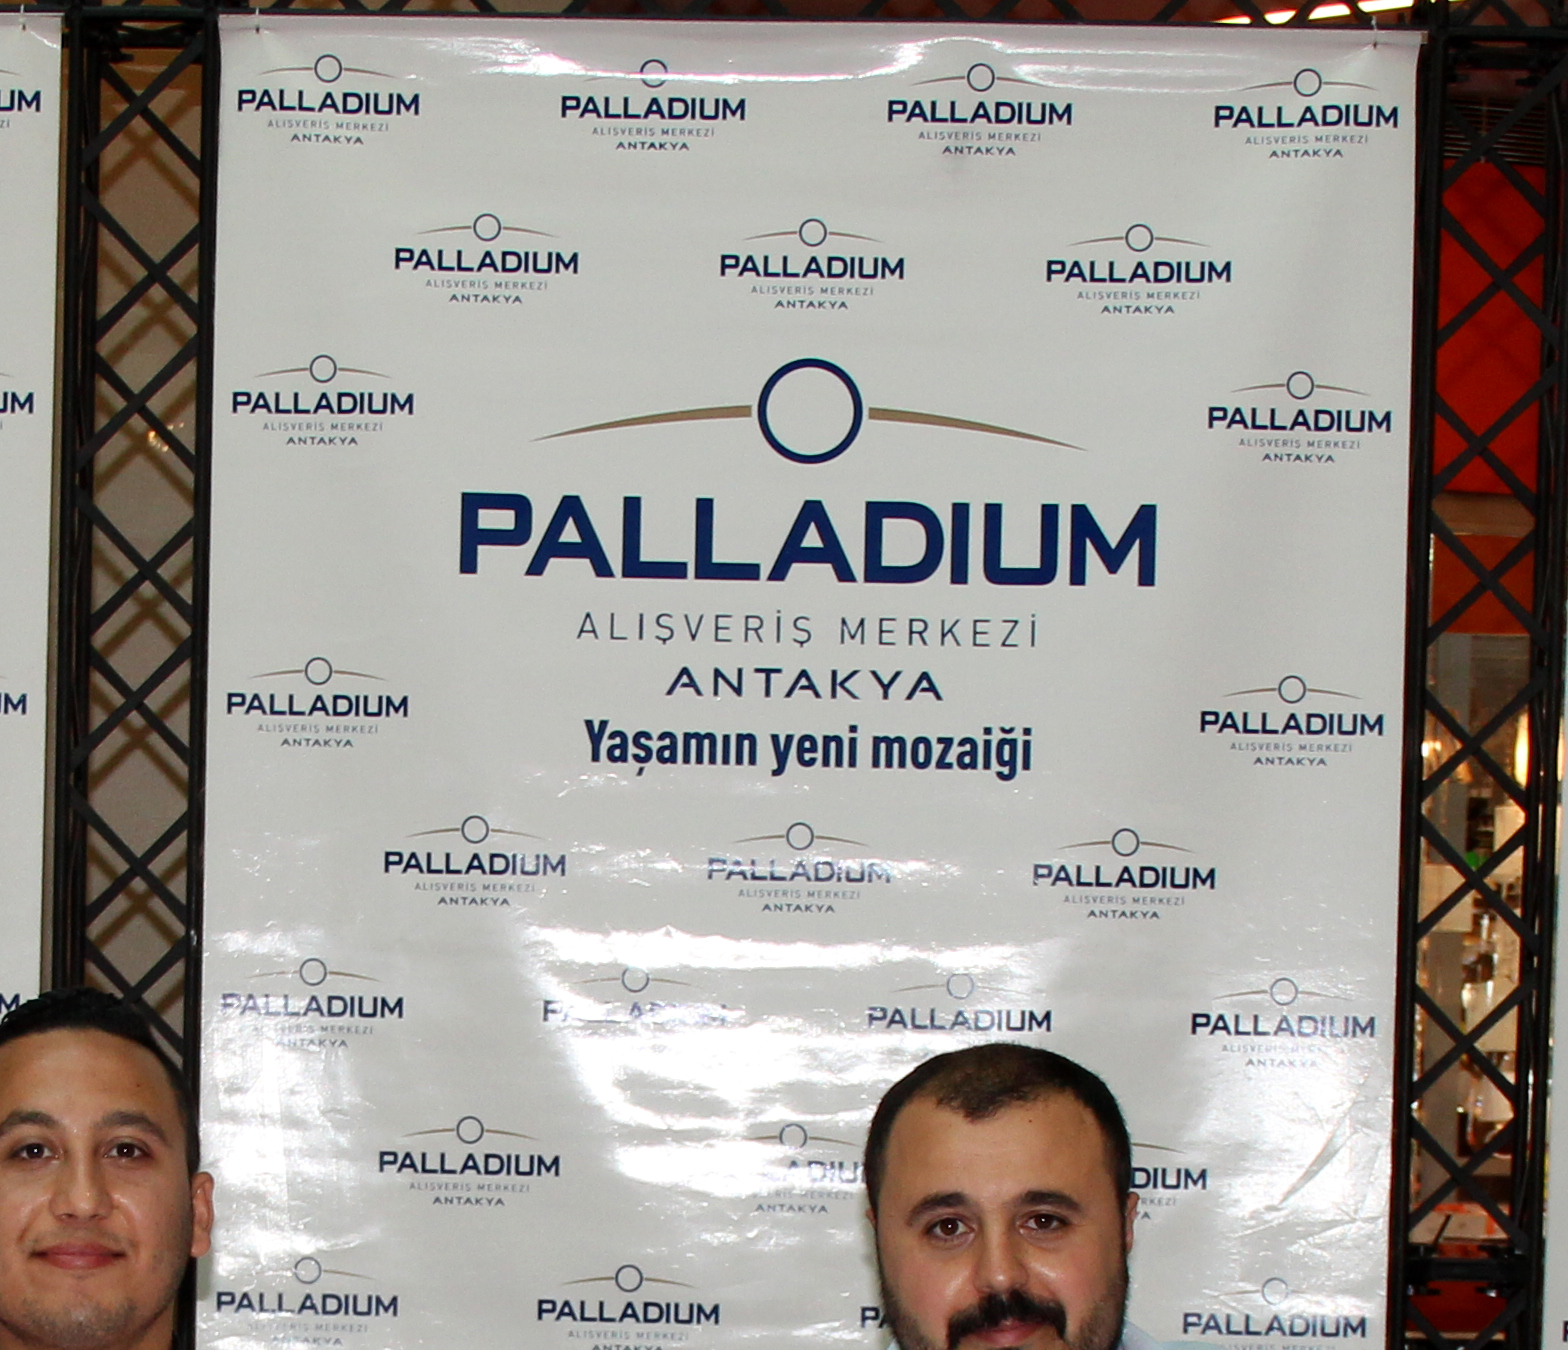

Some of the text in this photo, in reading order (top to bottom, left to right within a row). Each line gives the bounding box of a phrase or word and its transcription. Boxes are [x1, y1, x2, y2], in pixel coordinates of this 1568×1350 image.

[238, 89, 419, 115] PALLADIUM
[562, 96, 745, 120] PALLADIUM
[888, 100, 1072, 125] PALLADIUM
[1215, 104, 1398, 128] PALLADIUM
[616, 142, 689, 150] ANTAKYA
[395, 248, 578, 274] PALLADIUM
[721, 255, 904, 279] PALLADIUM
[1047, 260, 1231, 283] PALLADIUM
[1101, 305, 1174, 314] ANTAKYA
[233, 392, 413, 415] PALLADIUM
[1209, 407, 1391, 433] PALLADIUM
[460, 492, 1157, 586] PALLADIUM
[577, 610, 1035, 647] ALIŞVERİŞ MERKEZİ
[666, 667, 943, 700] ANTAKYA
[227, 693, 408, 717] PALLADIUM
[1200, 711, 1383, 736] PALLADIUM
[281, 738, 353, 747] ANTAKYA
[584, 720, 1031, 781] Yaşamın yeni mozaiği
[1254, 757, 1327, 766] ANTAKYA
[385, 851, 565, 876] PALLADIUM
[1034, 864, 1215, 889] PALLADIUM
[380, 1151, 559, 1176] PALLADIUM
[217, 1291, 398, 1316] PALLADIUM
[538, 1299, 719, 1325] PALLADIUM
[1183, 1313, 1366, 1338] PALLADIUM
